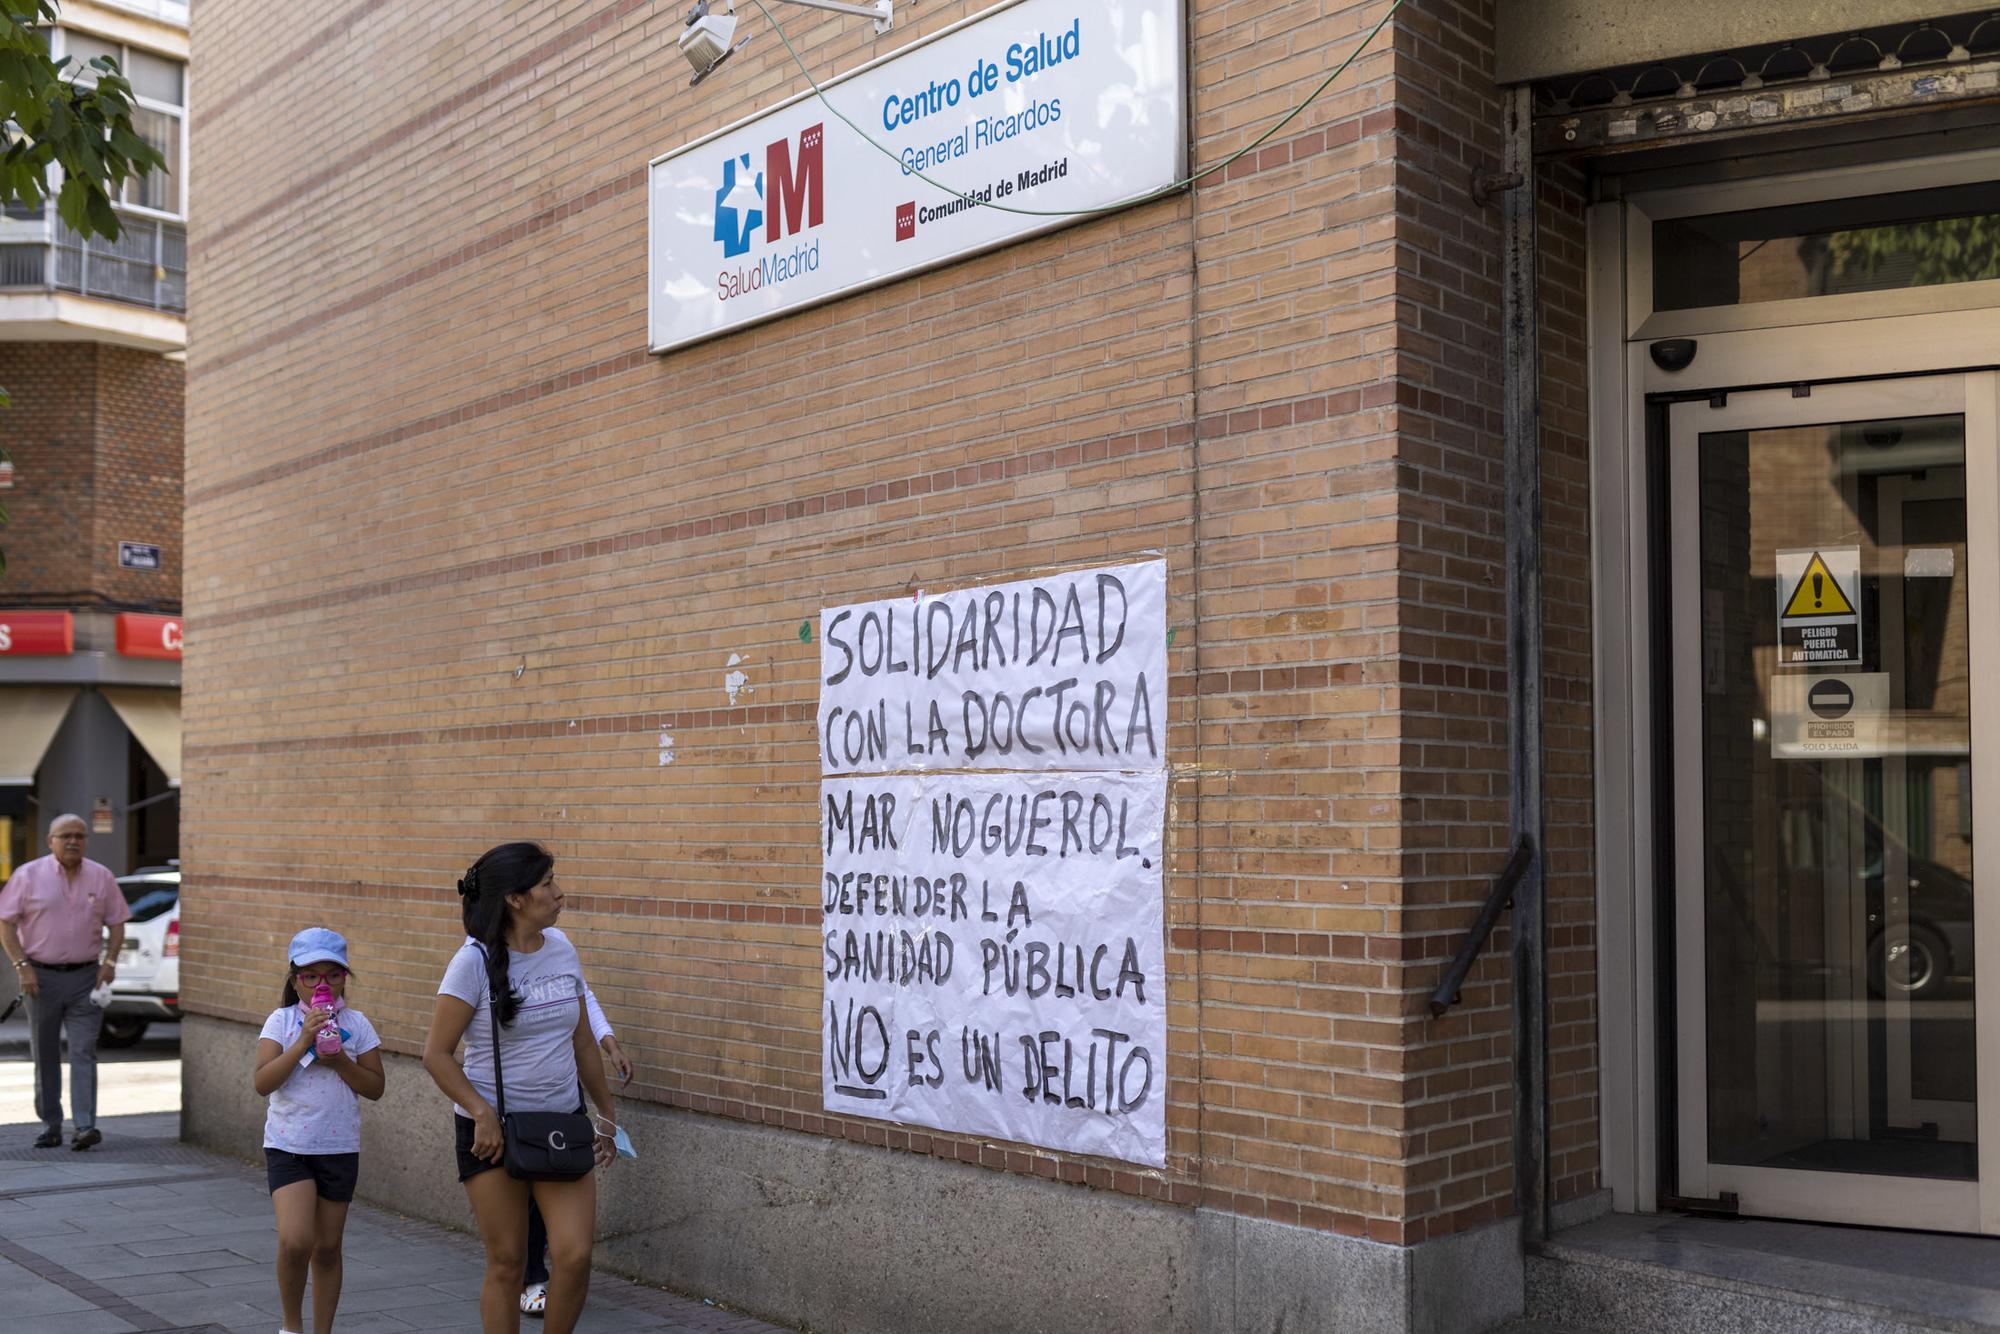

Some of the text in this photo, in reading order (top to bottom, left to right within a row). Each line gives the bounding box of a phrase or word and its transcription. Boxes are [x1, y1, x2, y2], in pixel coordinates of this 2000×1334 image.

[883, 17, 1080, 132] Centro de Salud
[901, 98, 1062, 176] General Ricardos
[918, 157, 1068, 225] Comunidad de Madrid
[826, 574, 1128, 686] SOLIDARIDAD
[1792, 649, 1849, 662] AUTOMATICA
[1801, 626, 1838, 639] PELIGRO
[1803, 638, 1837, 650] PUERTA
[826, 671, 1158, 768] CON LA DOCTORA
[1802, 742, 1859, 752] SOLO SALIDA
[1808, 722, 1854, 730] PROHIBIDO
[1813, 729, 1850, 737] EL PASO
[826, 789, 898, 857] MAR
[824, 871, 1032, 928] DEFENDER LA
[825, 928, 1146, 1005] SANIDAD PÚBLICA
[829, 996, 1152, 1116] NO ES UN DELITO
[548, 1130, 566, 1150] C
